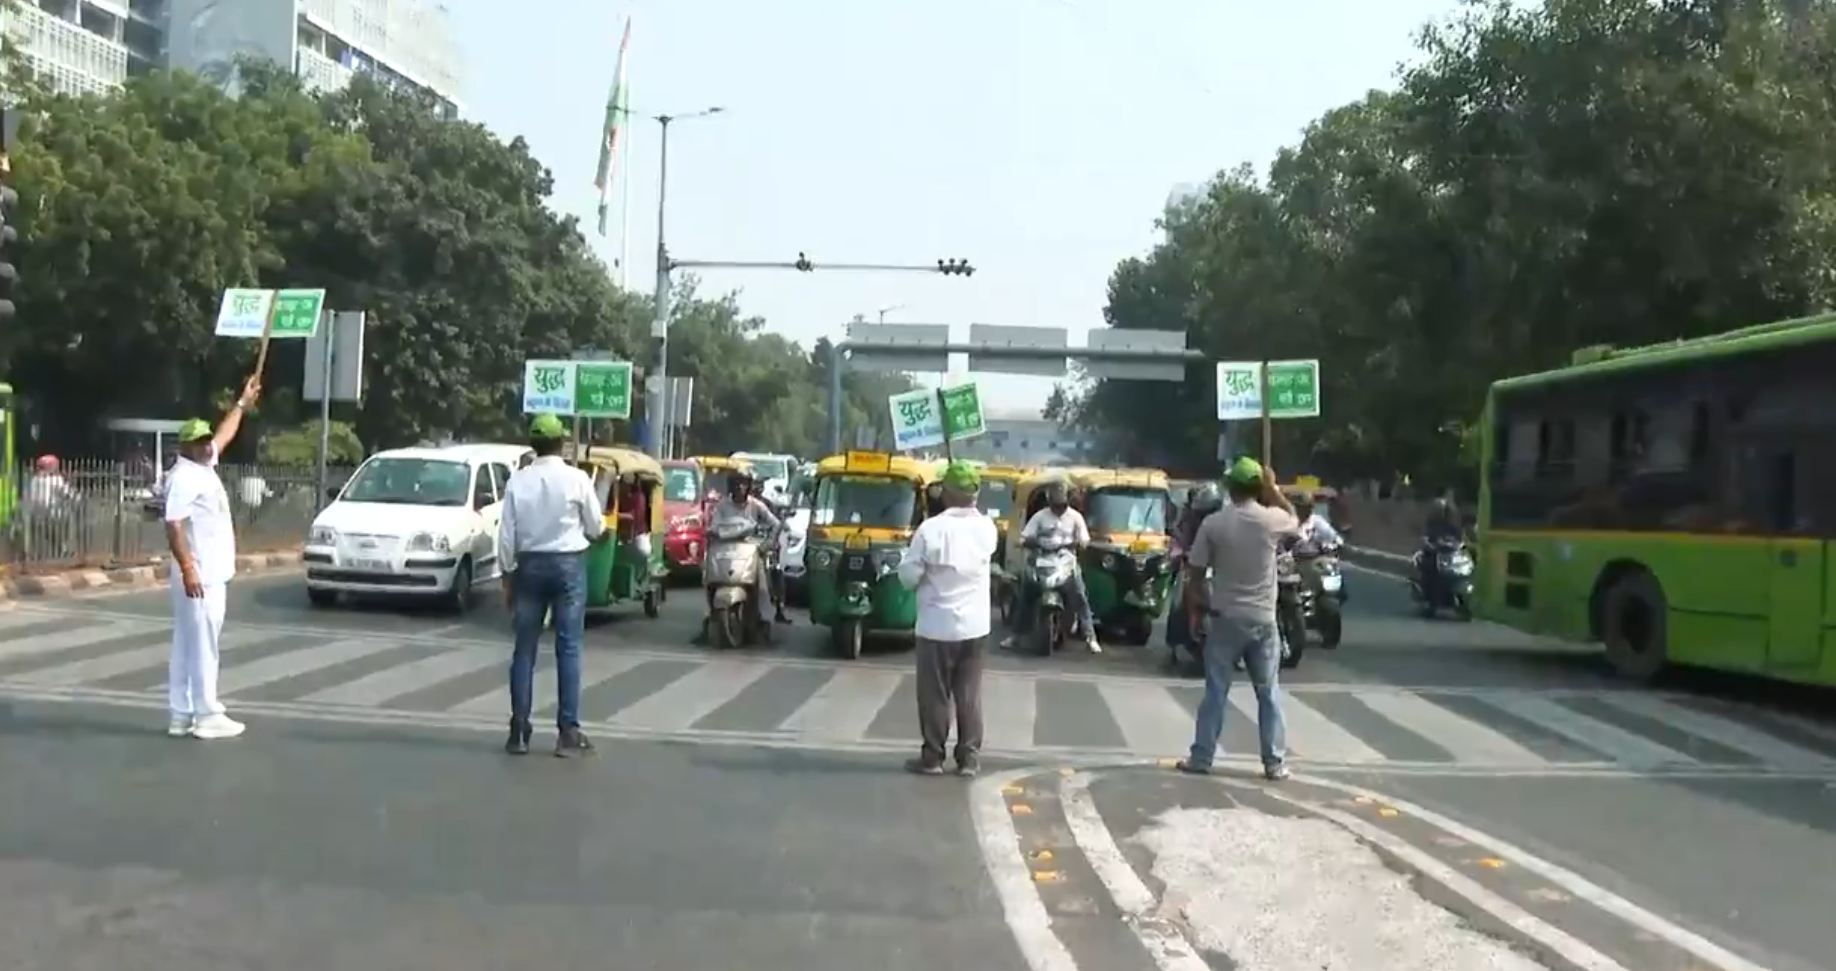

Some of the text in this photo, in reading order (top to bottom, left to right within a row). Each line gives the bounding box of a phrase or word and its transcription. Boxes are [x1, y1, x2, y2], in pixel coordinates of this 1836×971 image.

[534, 367, 566, 393] युद्ध
[1224, 370, 1254, 396] युद्ध
[898, 397, 932, 427] युद्ध
